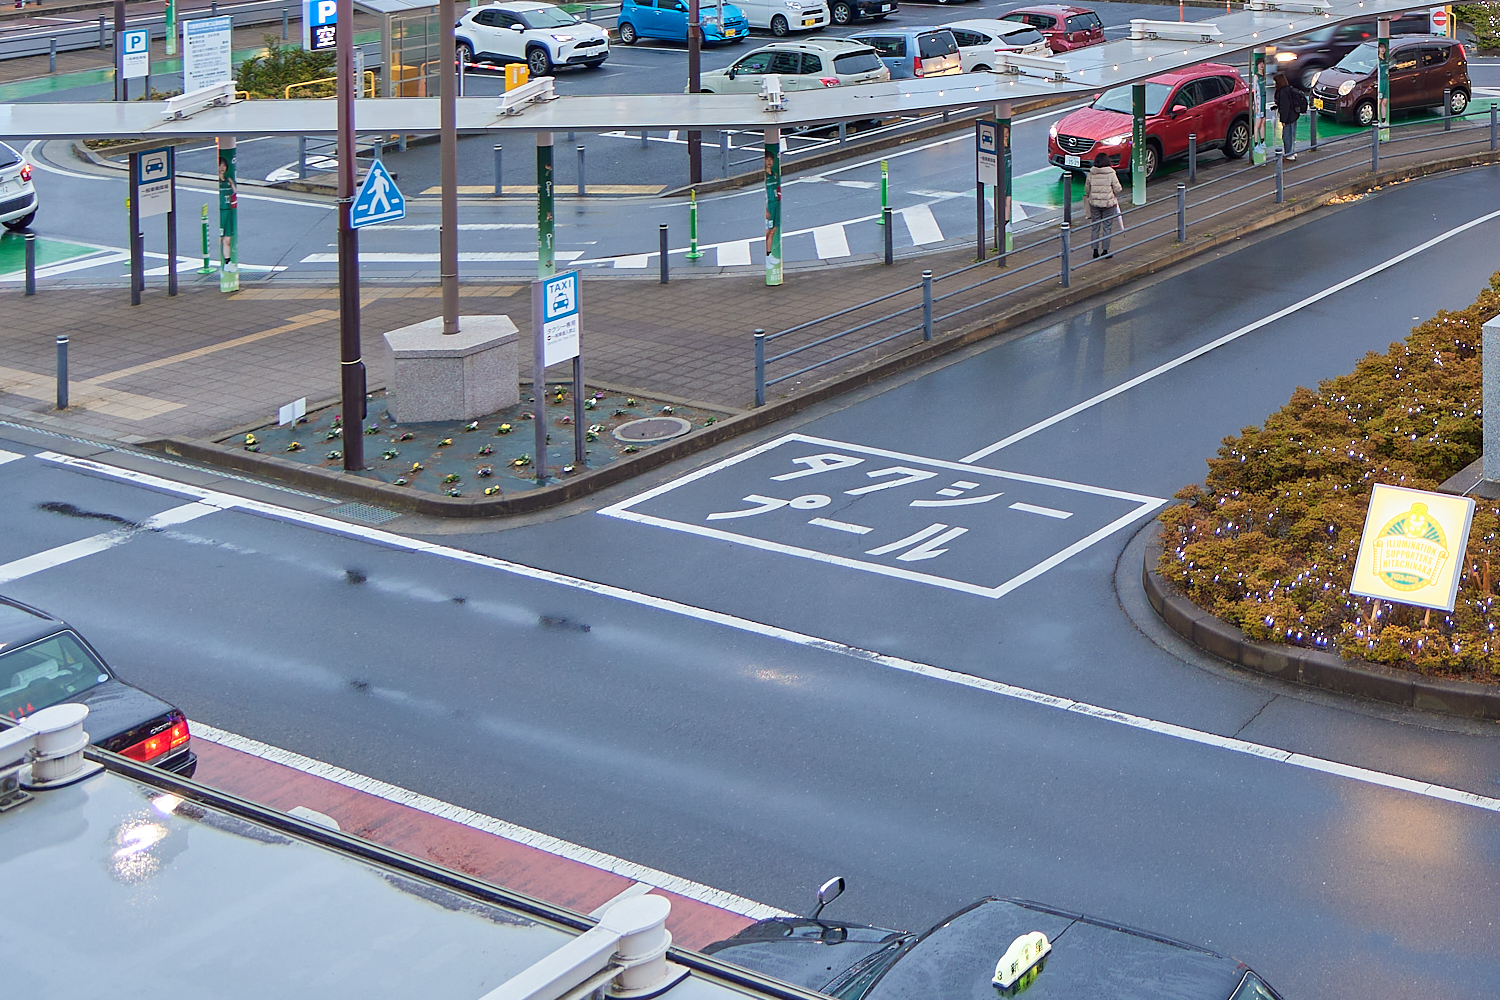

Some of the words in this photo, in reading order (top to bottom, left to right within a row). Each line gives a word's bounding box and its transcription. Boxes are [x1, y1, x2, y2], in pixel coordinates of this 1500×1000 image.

[317, 0, 337, 24] P
[131, 35, 142, 49] P
[549, 279, 572, 294] TAXI
[769, 452, 1075, 520] タクシー
[706, 493, 969, 562] プール
[1386, 540, 1438, 556] ILLUMINATION
[1385, 549, 1434, 566] SUPPORTERS
[1382, 559, 1433, 576] HITACHINAKA
